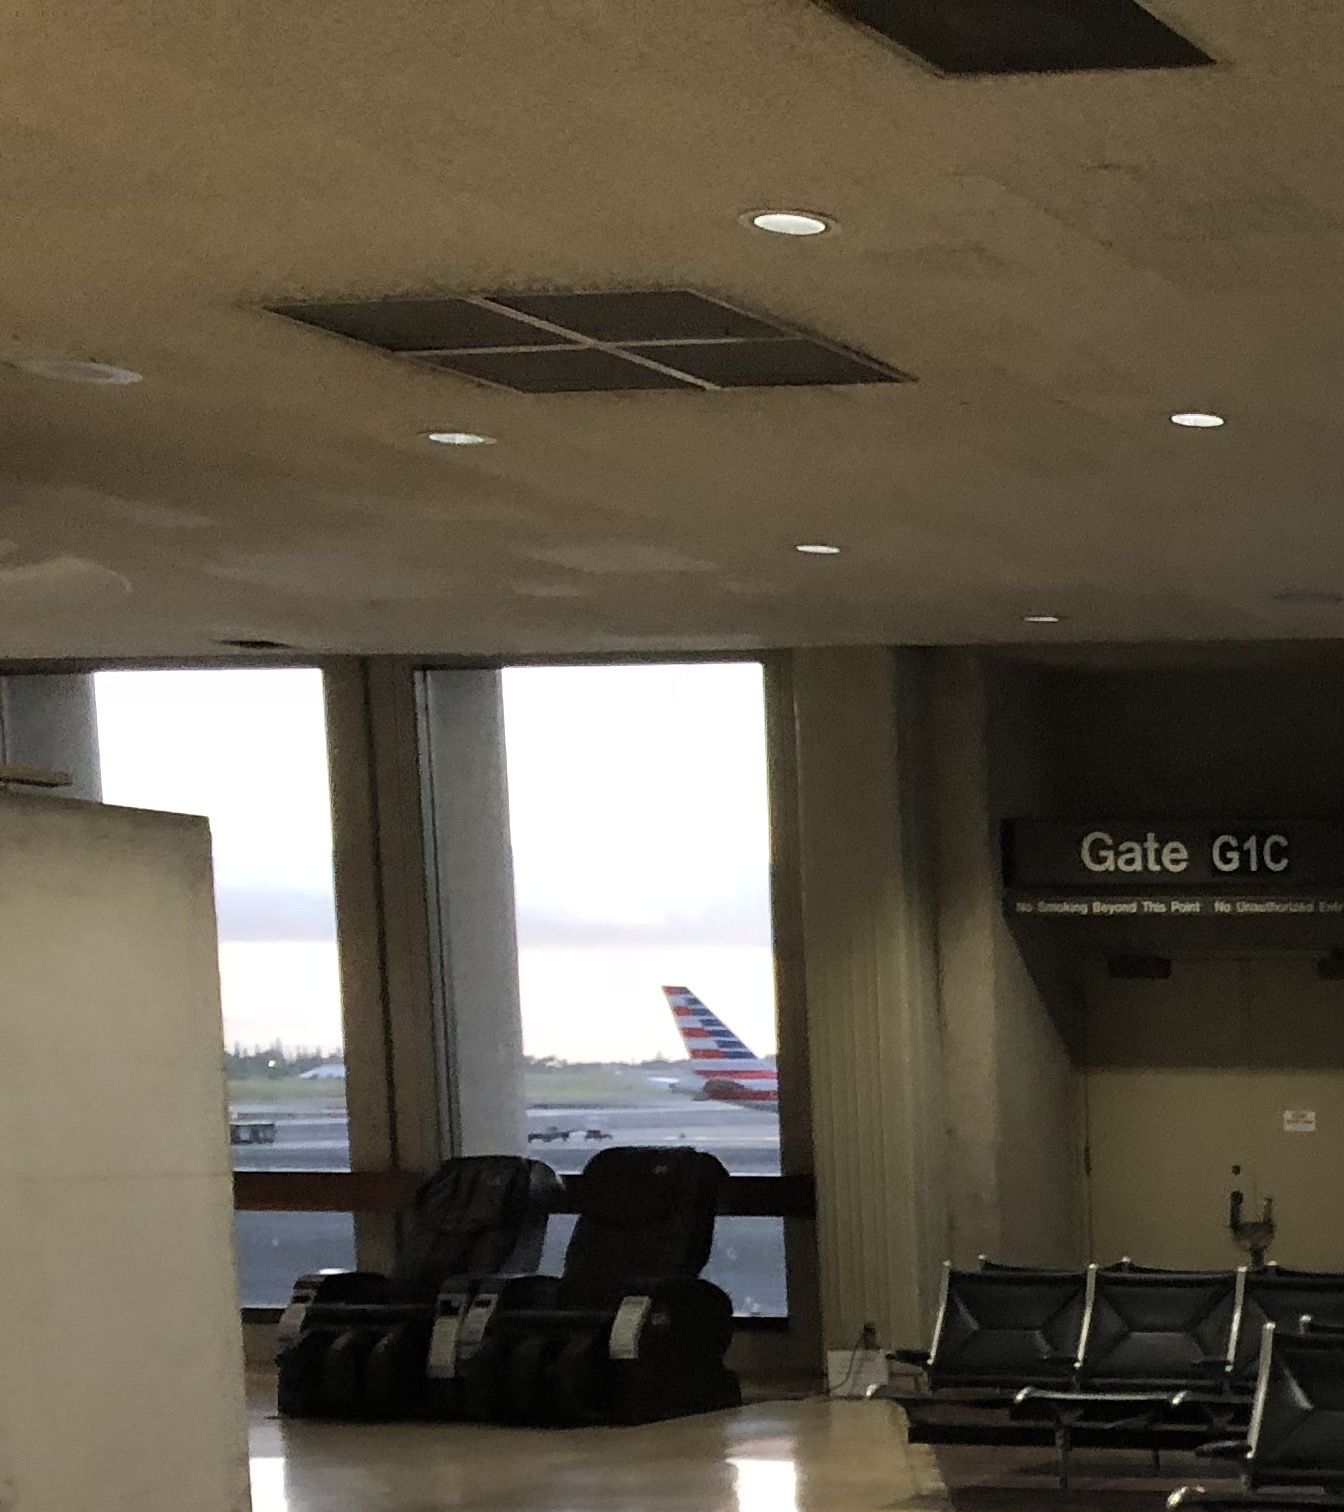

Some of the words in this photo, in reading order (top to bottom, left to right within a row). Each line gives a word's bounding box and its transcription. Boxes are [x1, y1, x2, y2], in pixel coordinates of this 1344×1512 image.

[1081, 831, 1189, 873] Gate
[1212, 834, 1289, 872] G1C
[1016, 902, 1032, 913] No
[1038, 902, 1088, 915] Smoking
[1092, 902, 1137, 915] Beyond
[1143, 901, 1167, 913] This
[1171, 901, 1201, 913] Point
[1215, 902, 1231, 913] No
[1237, 902, 1314, 914] Unauthorized
